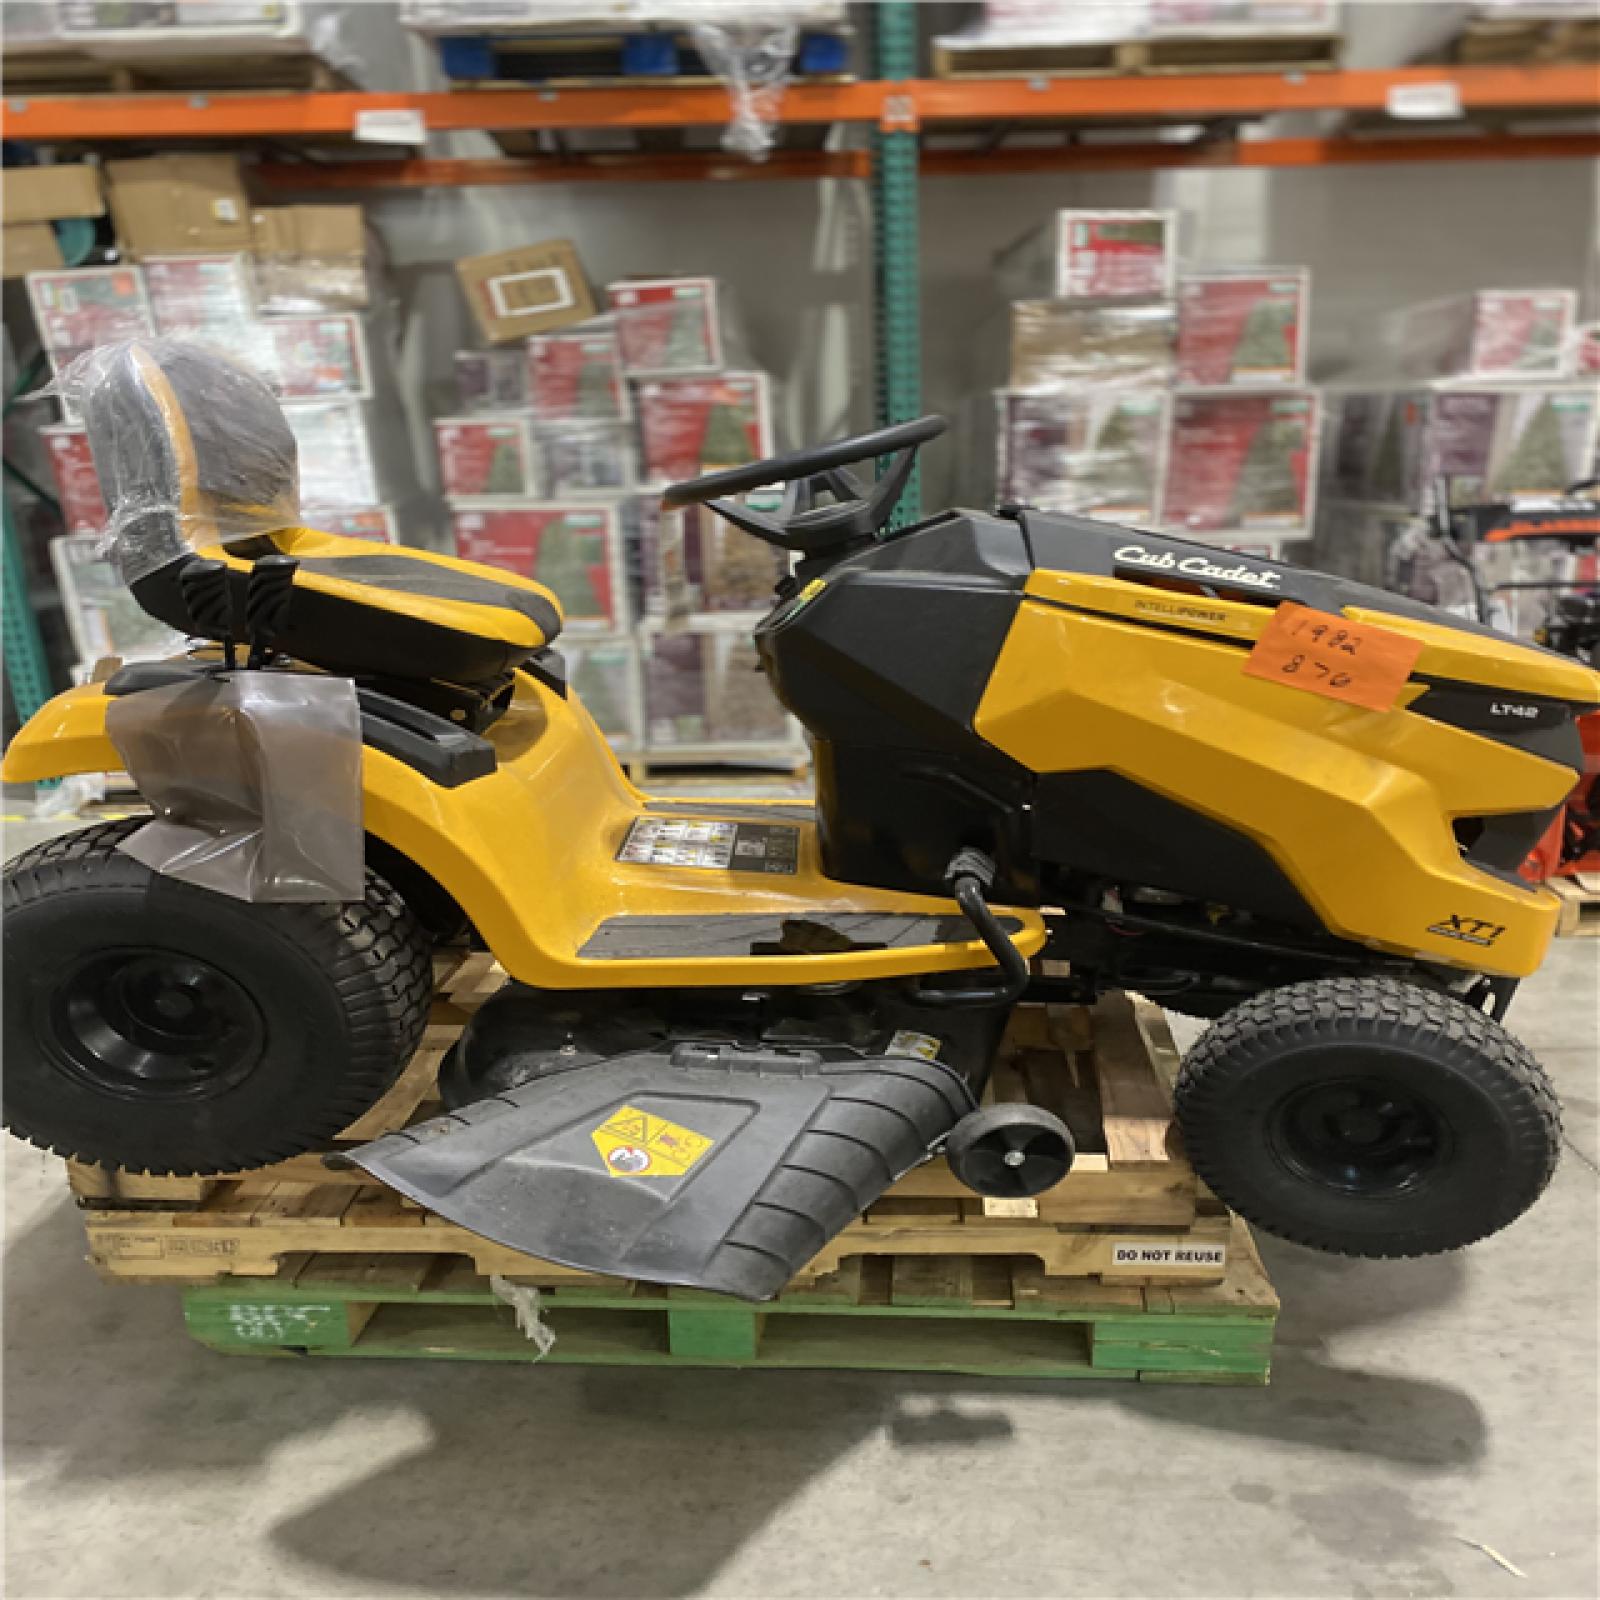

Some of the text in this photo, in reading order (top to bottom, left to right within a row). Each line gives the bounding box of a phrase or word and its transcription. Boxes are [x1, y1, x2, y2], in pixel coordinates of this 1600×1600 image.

[1113, 544, 1281, 589] Cub Cadet
[1117, 1249, 1223, 1263] DO NOT REUSE
